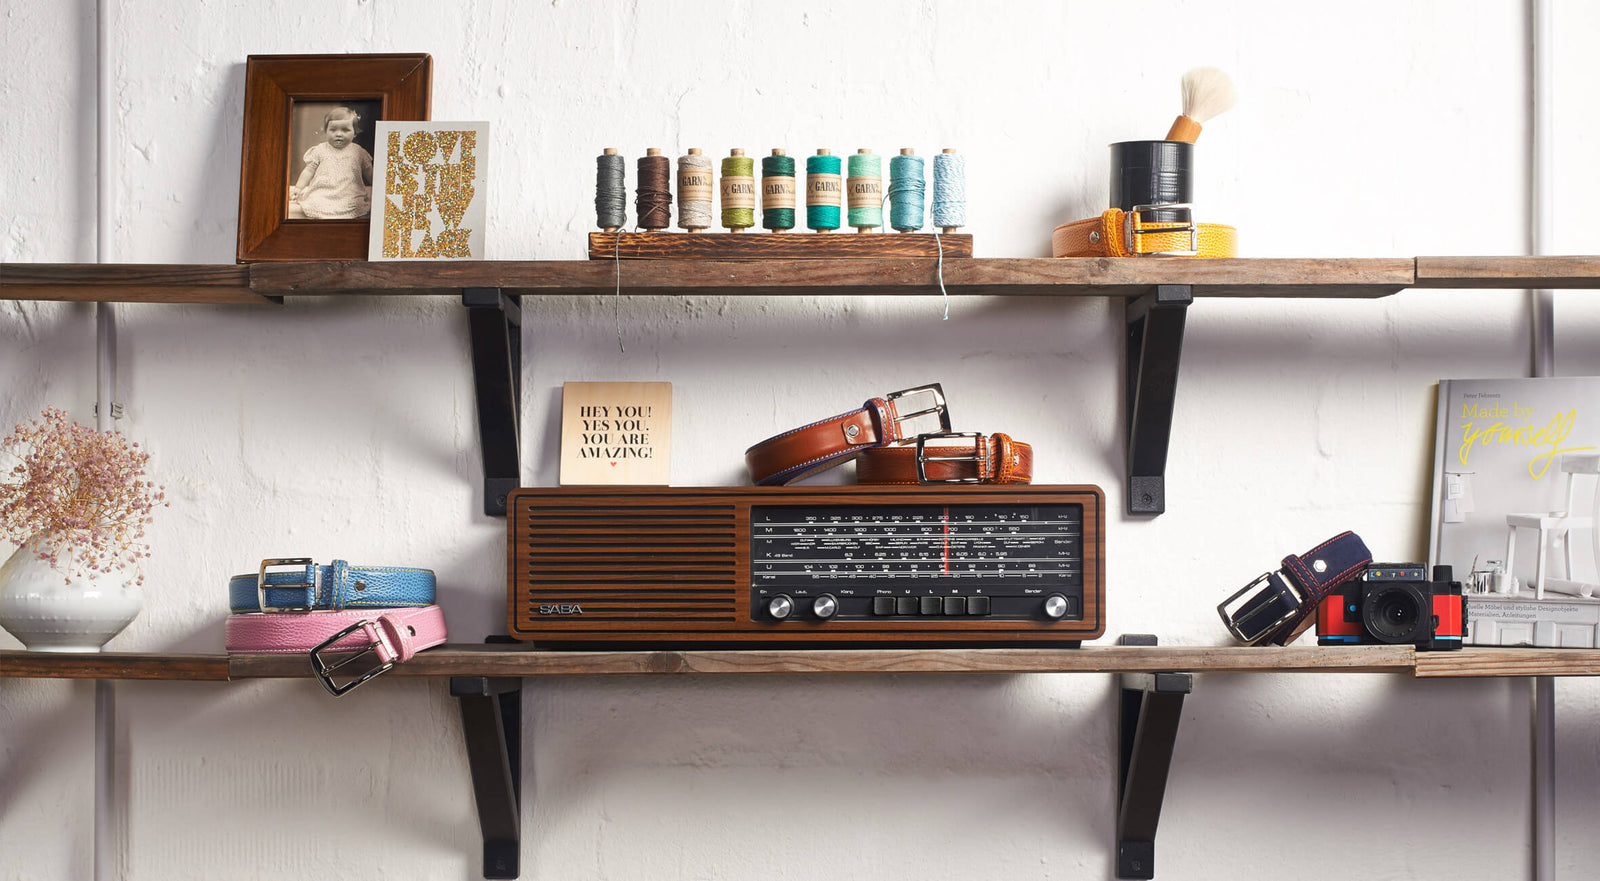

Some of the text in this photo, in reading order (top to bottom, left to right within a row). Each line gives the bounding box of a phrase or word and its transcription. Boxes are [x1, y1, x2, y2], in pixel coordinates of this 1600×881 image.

[387, 130, 477, 163] LOVE
[682, 176, 703, 186] GARN
[815, 181, 836, 191] GARN
[731, 184, 751, 194] GARN
[766, 184, 786, 194] GARN
[855, 184, 875, 193] GARN
[382, 228, 472, 258] BLACK
[580, 406, 652, 418] HEY YOU!
[1461, 402, 1535, 421] Made by
[582, 420, 649, 431] YES YOU.
[582, 433, 650, 445] YOU ARE
[1459, 408, 1598, 480] yourself
[576, 447, 653, 459] AMAZING!
[540, 604, 583, 615] SABA
